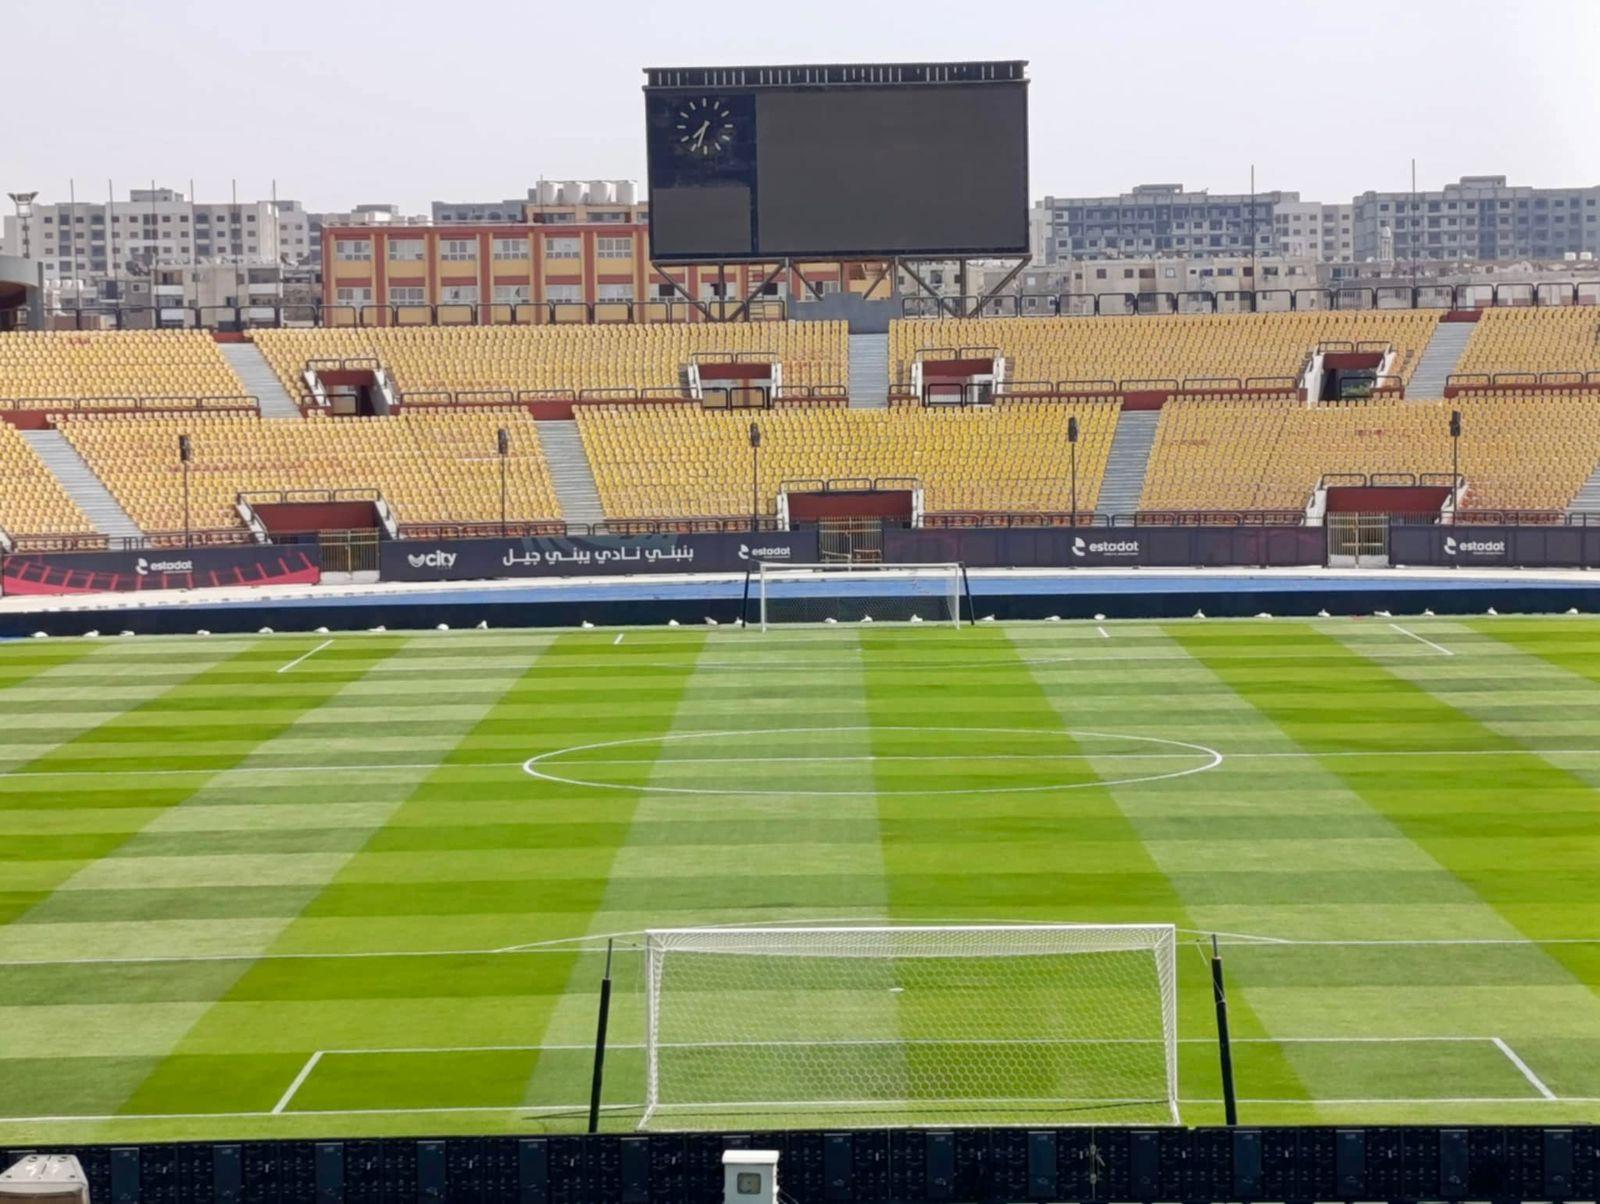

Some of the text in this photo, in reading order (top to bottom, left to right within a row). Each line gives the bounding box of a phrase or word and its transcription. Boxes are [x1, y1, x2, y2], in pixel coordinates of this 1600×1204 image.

[425, 550, 457, 567] city
[502, 545, 694, 566] بنبني نادي يبني جيل
